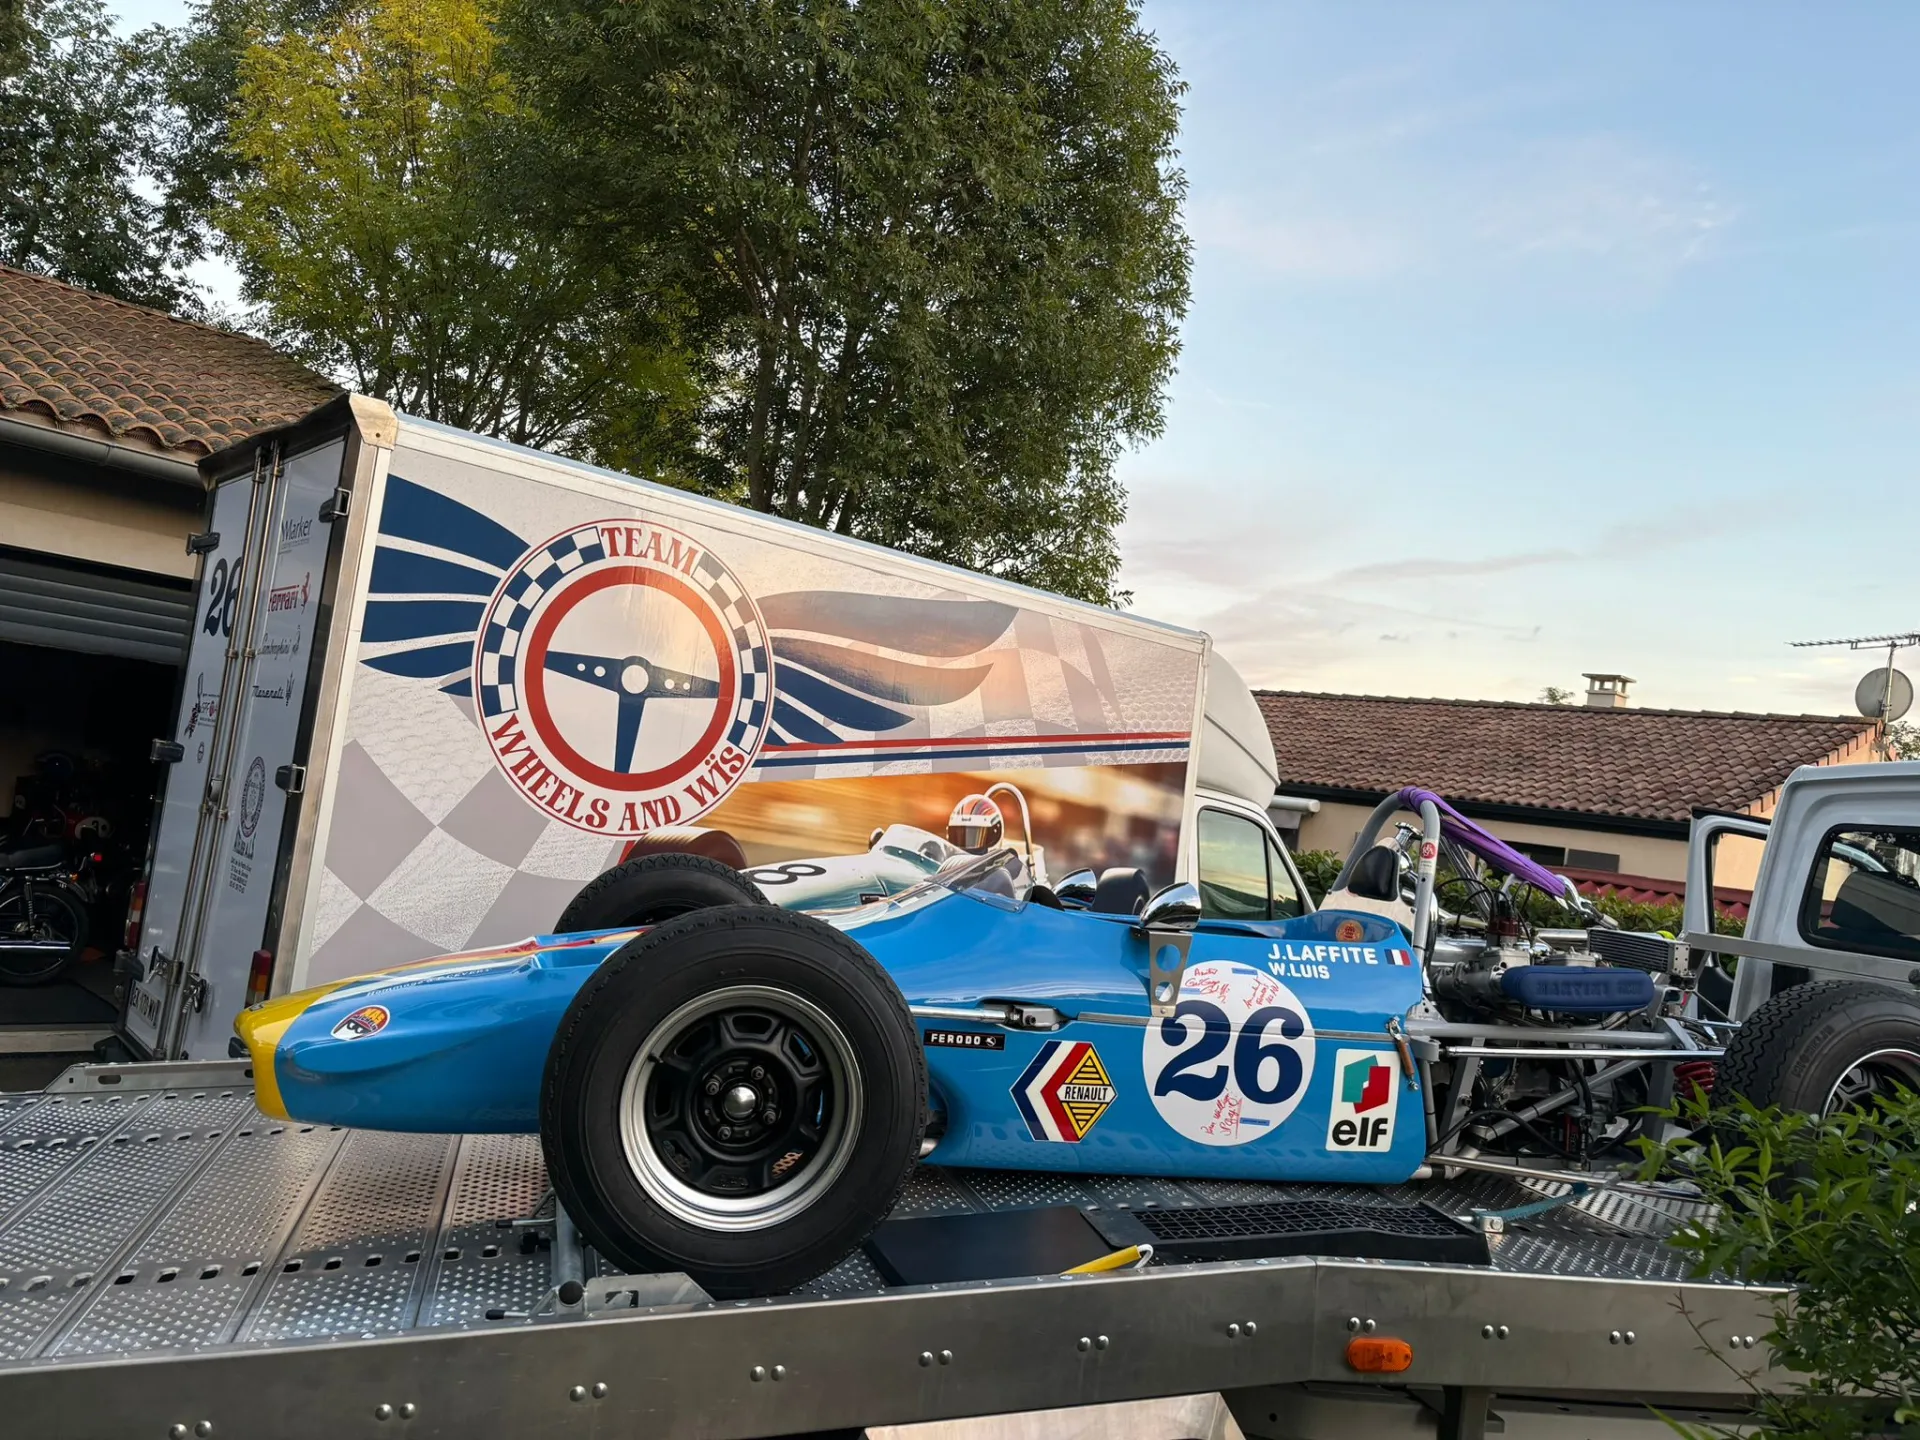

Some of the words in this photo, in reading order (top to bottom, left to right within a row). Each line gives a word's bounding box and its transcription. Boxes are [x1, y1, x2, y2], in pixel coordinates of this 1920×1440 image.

[601, 527, 700, 576] TEAM
[491, 713, 610, 829] WHEELS
[618, 795, 682, 831] AND
[1268, 943, 1379, 965] J.LAFFITE
[1268, 962, 1331, 979] W.LUIS
[931, 1033, 981, 1046] FERODO
[1154, 1000, 1305, 1105] 26
[1064, 1086, 1109, 1101] RENAULT
[1332, 1117, 1389, 1147] elf
